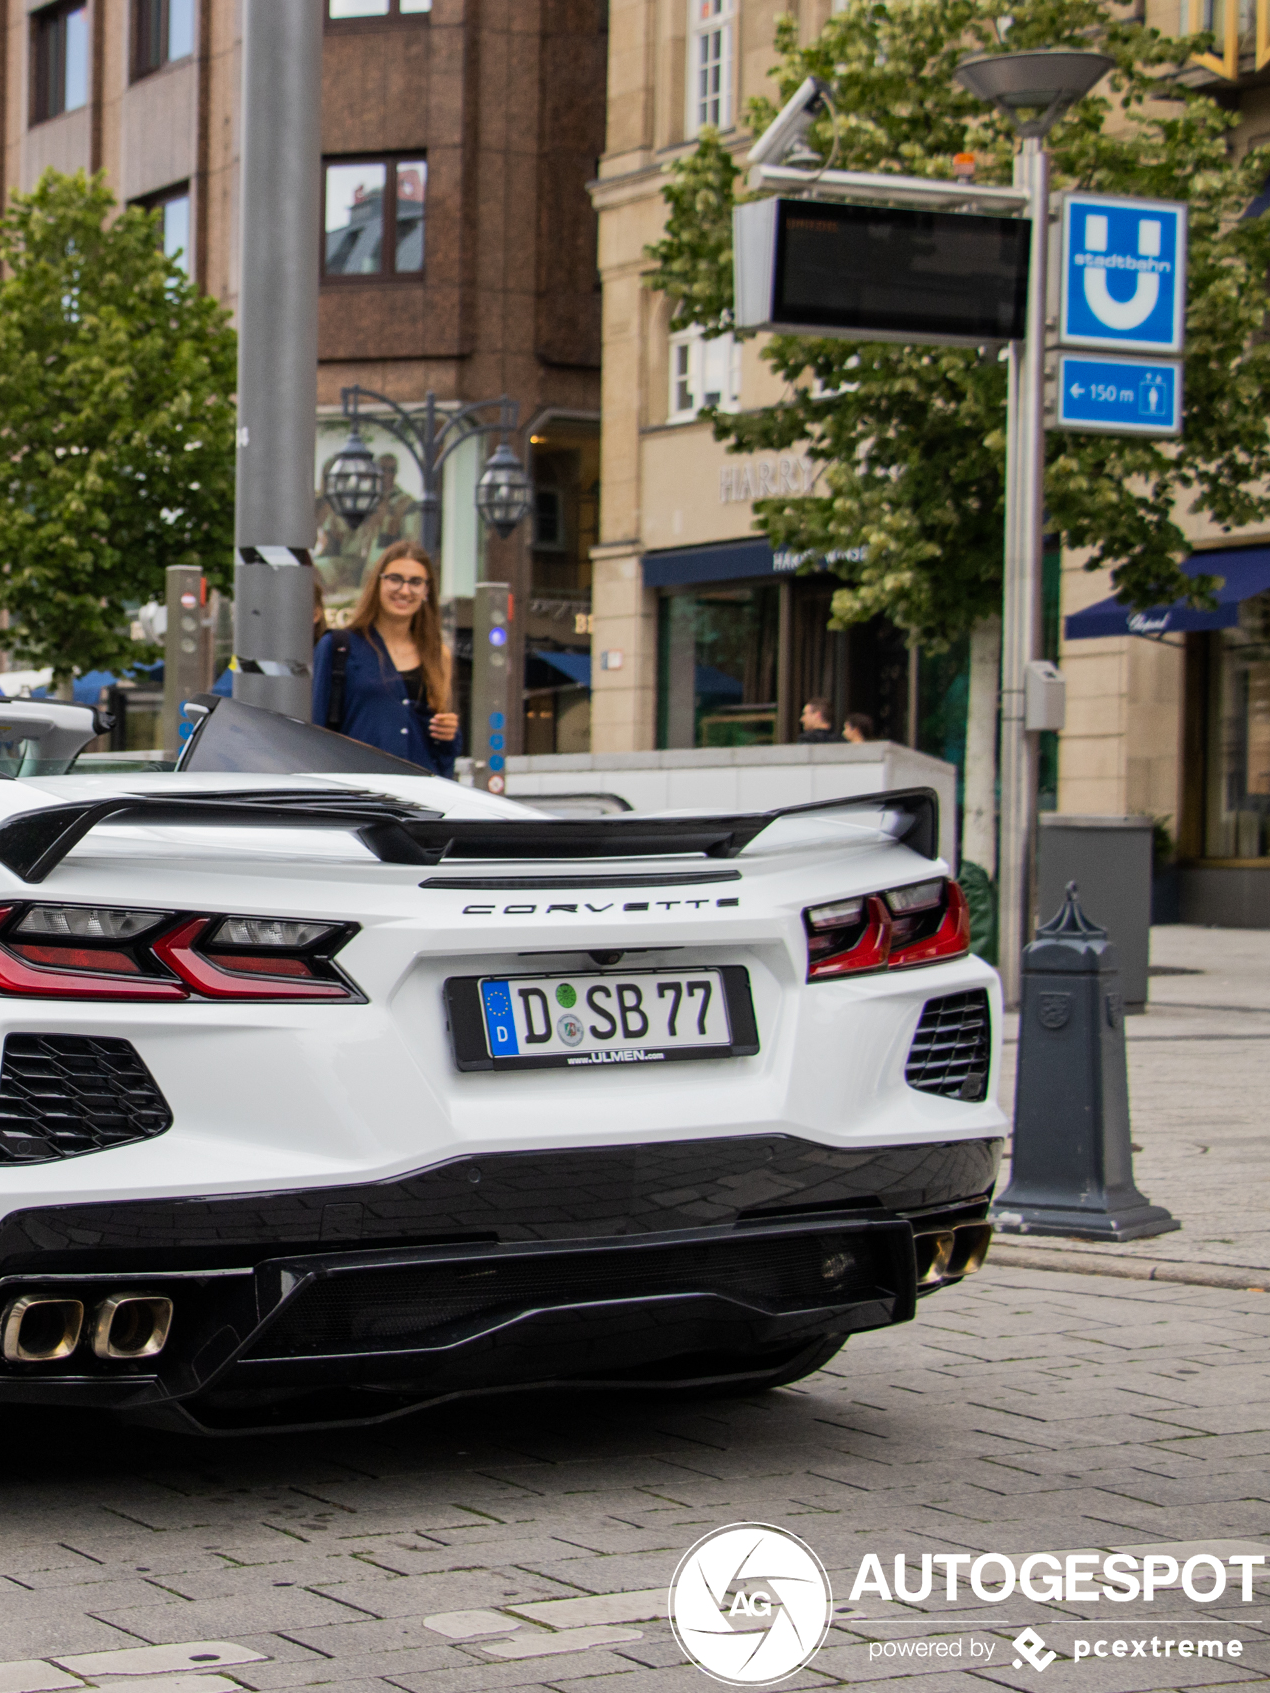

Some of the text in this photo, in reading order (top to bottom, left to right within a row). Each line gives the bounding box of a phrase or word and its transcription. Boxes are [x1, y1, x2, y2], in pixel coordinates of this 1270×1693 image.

[1074, 253, 1171, 273] stadtbahn
[1091, 384, 1135, 402] 150 m
[719, 457, 814, 502] HARRY
[462, 897, 740, 915] CORVETTE
[518, 980, 712, 1044] D SB 77
[496, 1025, 509, 1042] D
[567, 1049, 665, 1065] www.ULMEN.com
